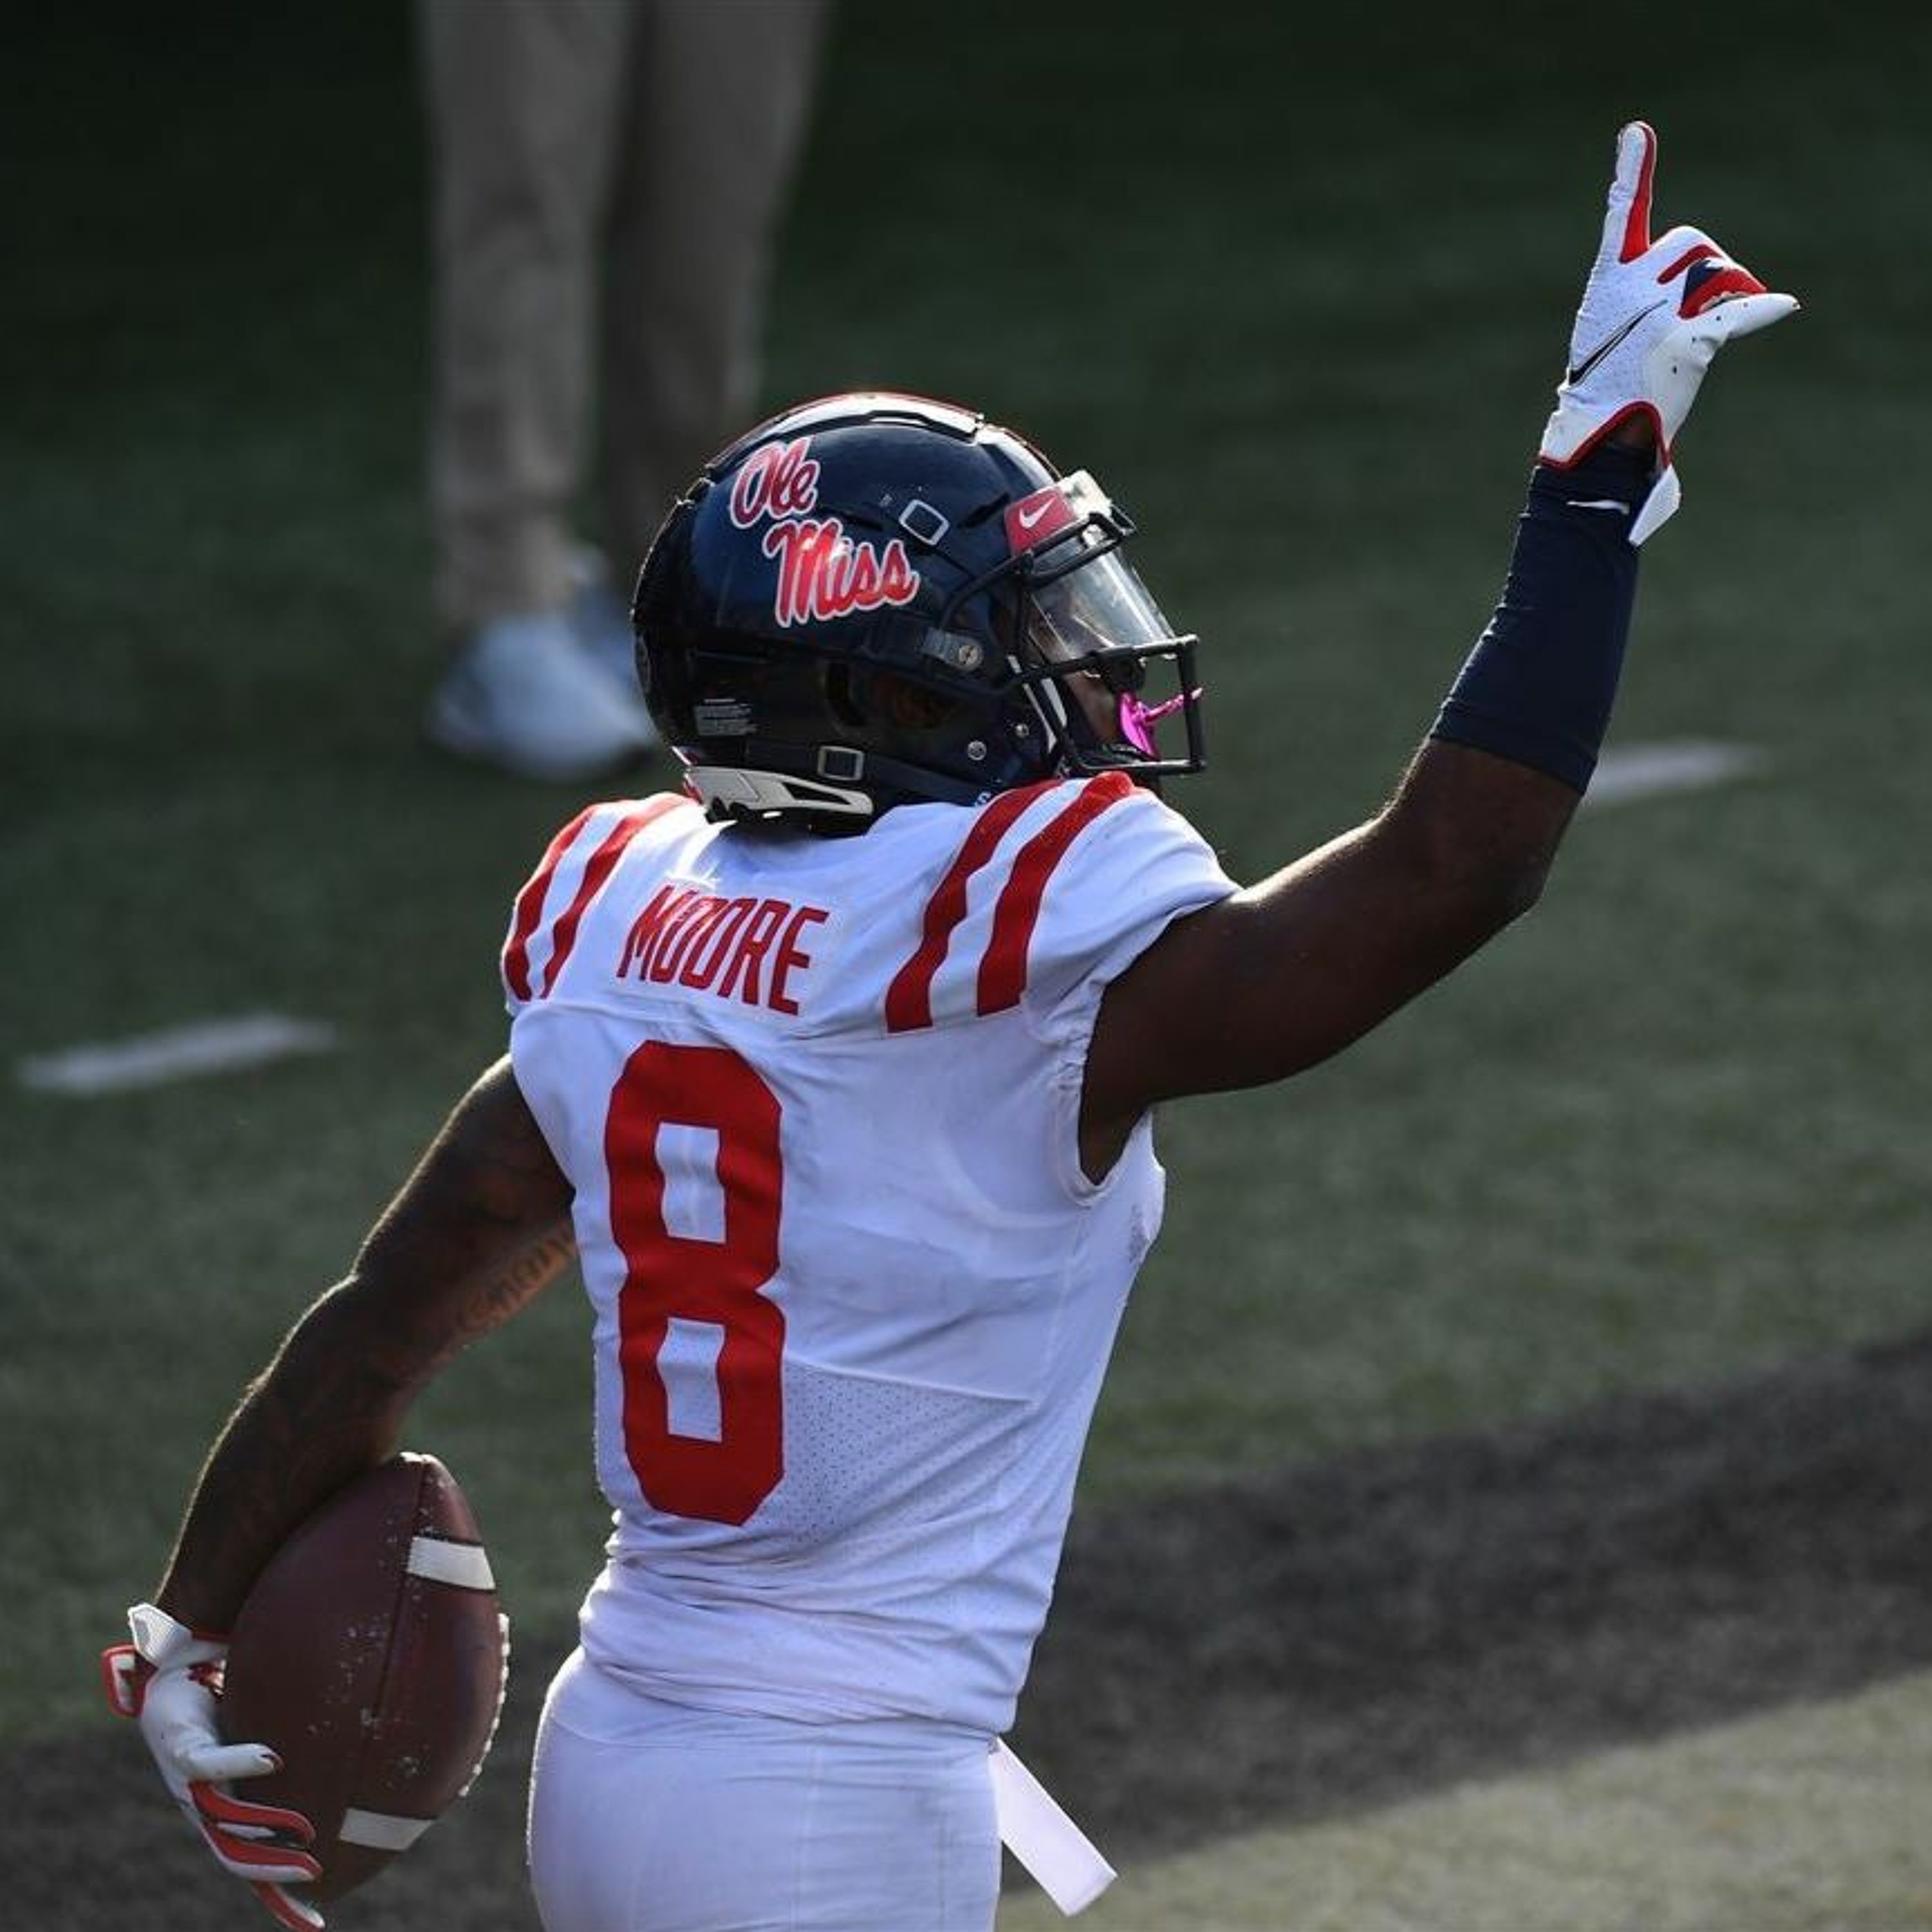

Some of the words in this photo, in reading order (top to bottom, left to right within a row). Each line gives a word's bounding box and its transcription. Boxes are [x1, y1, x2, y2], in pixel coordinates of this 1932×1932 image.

[730, 435, 820, 529] Ole
[762, 518, 920, 628] Miss
[616, 885, 829, 1016] MOORE
[604, 1039, 786, 1527] 8
